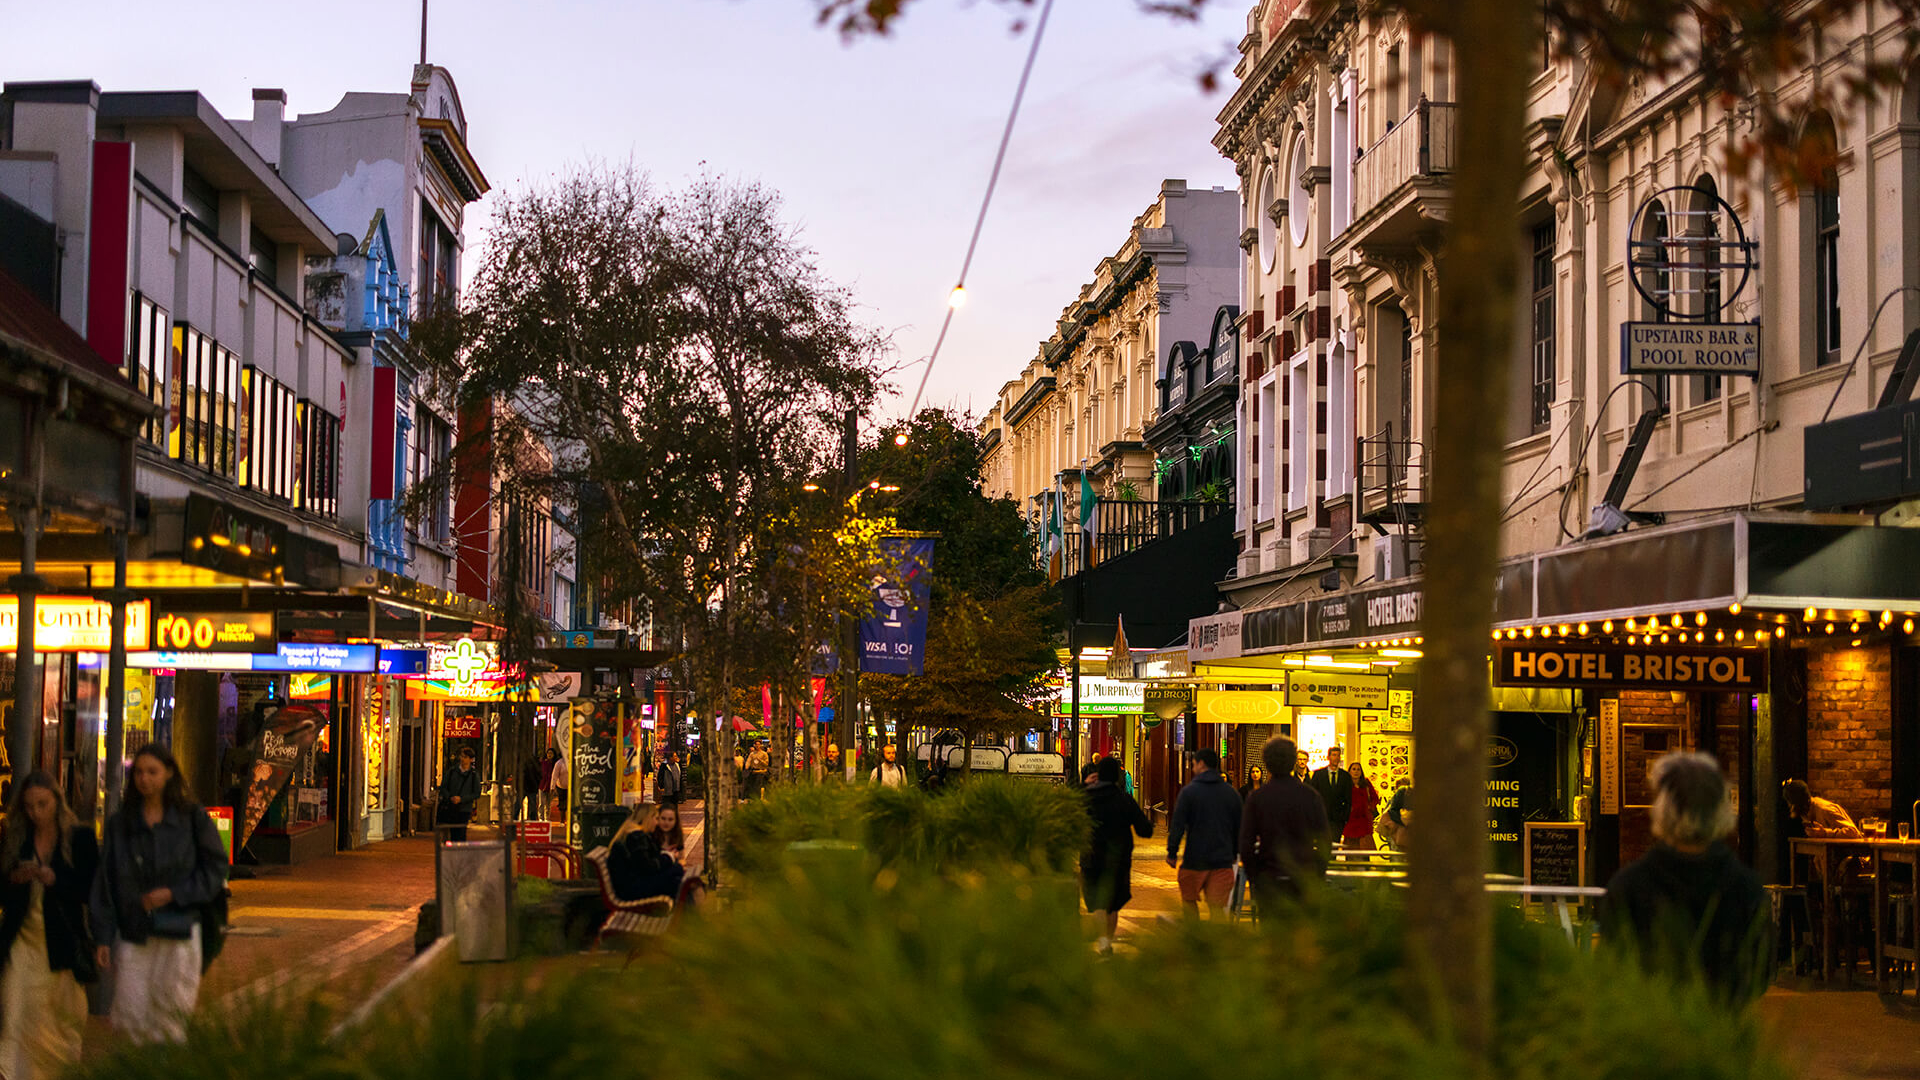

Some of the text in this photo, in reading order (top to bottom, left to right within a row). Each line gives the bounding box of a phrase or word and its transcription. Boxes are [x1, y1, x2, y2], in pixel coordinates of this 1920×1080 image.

[1634, 329, 1755, 345] UPSTAIRS BAR &
[1640, 349, 1747, 366] POOL ROOM
[1367, 591, 1422, 627] HOTEL BRIST
[865, 641, 887, 652] VISA
[1513, 651, 1751, 683] HOTEL BRISTOL
[1348, 685, 1386, 694] Top Kitchen
[1093, 704, 1118, 712] GAMING
[1119, 704, 1143, 712] LOUNGE
[1218, 700, 1270, 714] ABSTRACT
[581, 743, 599, 752] The
